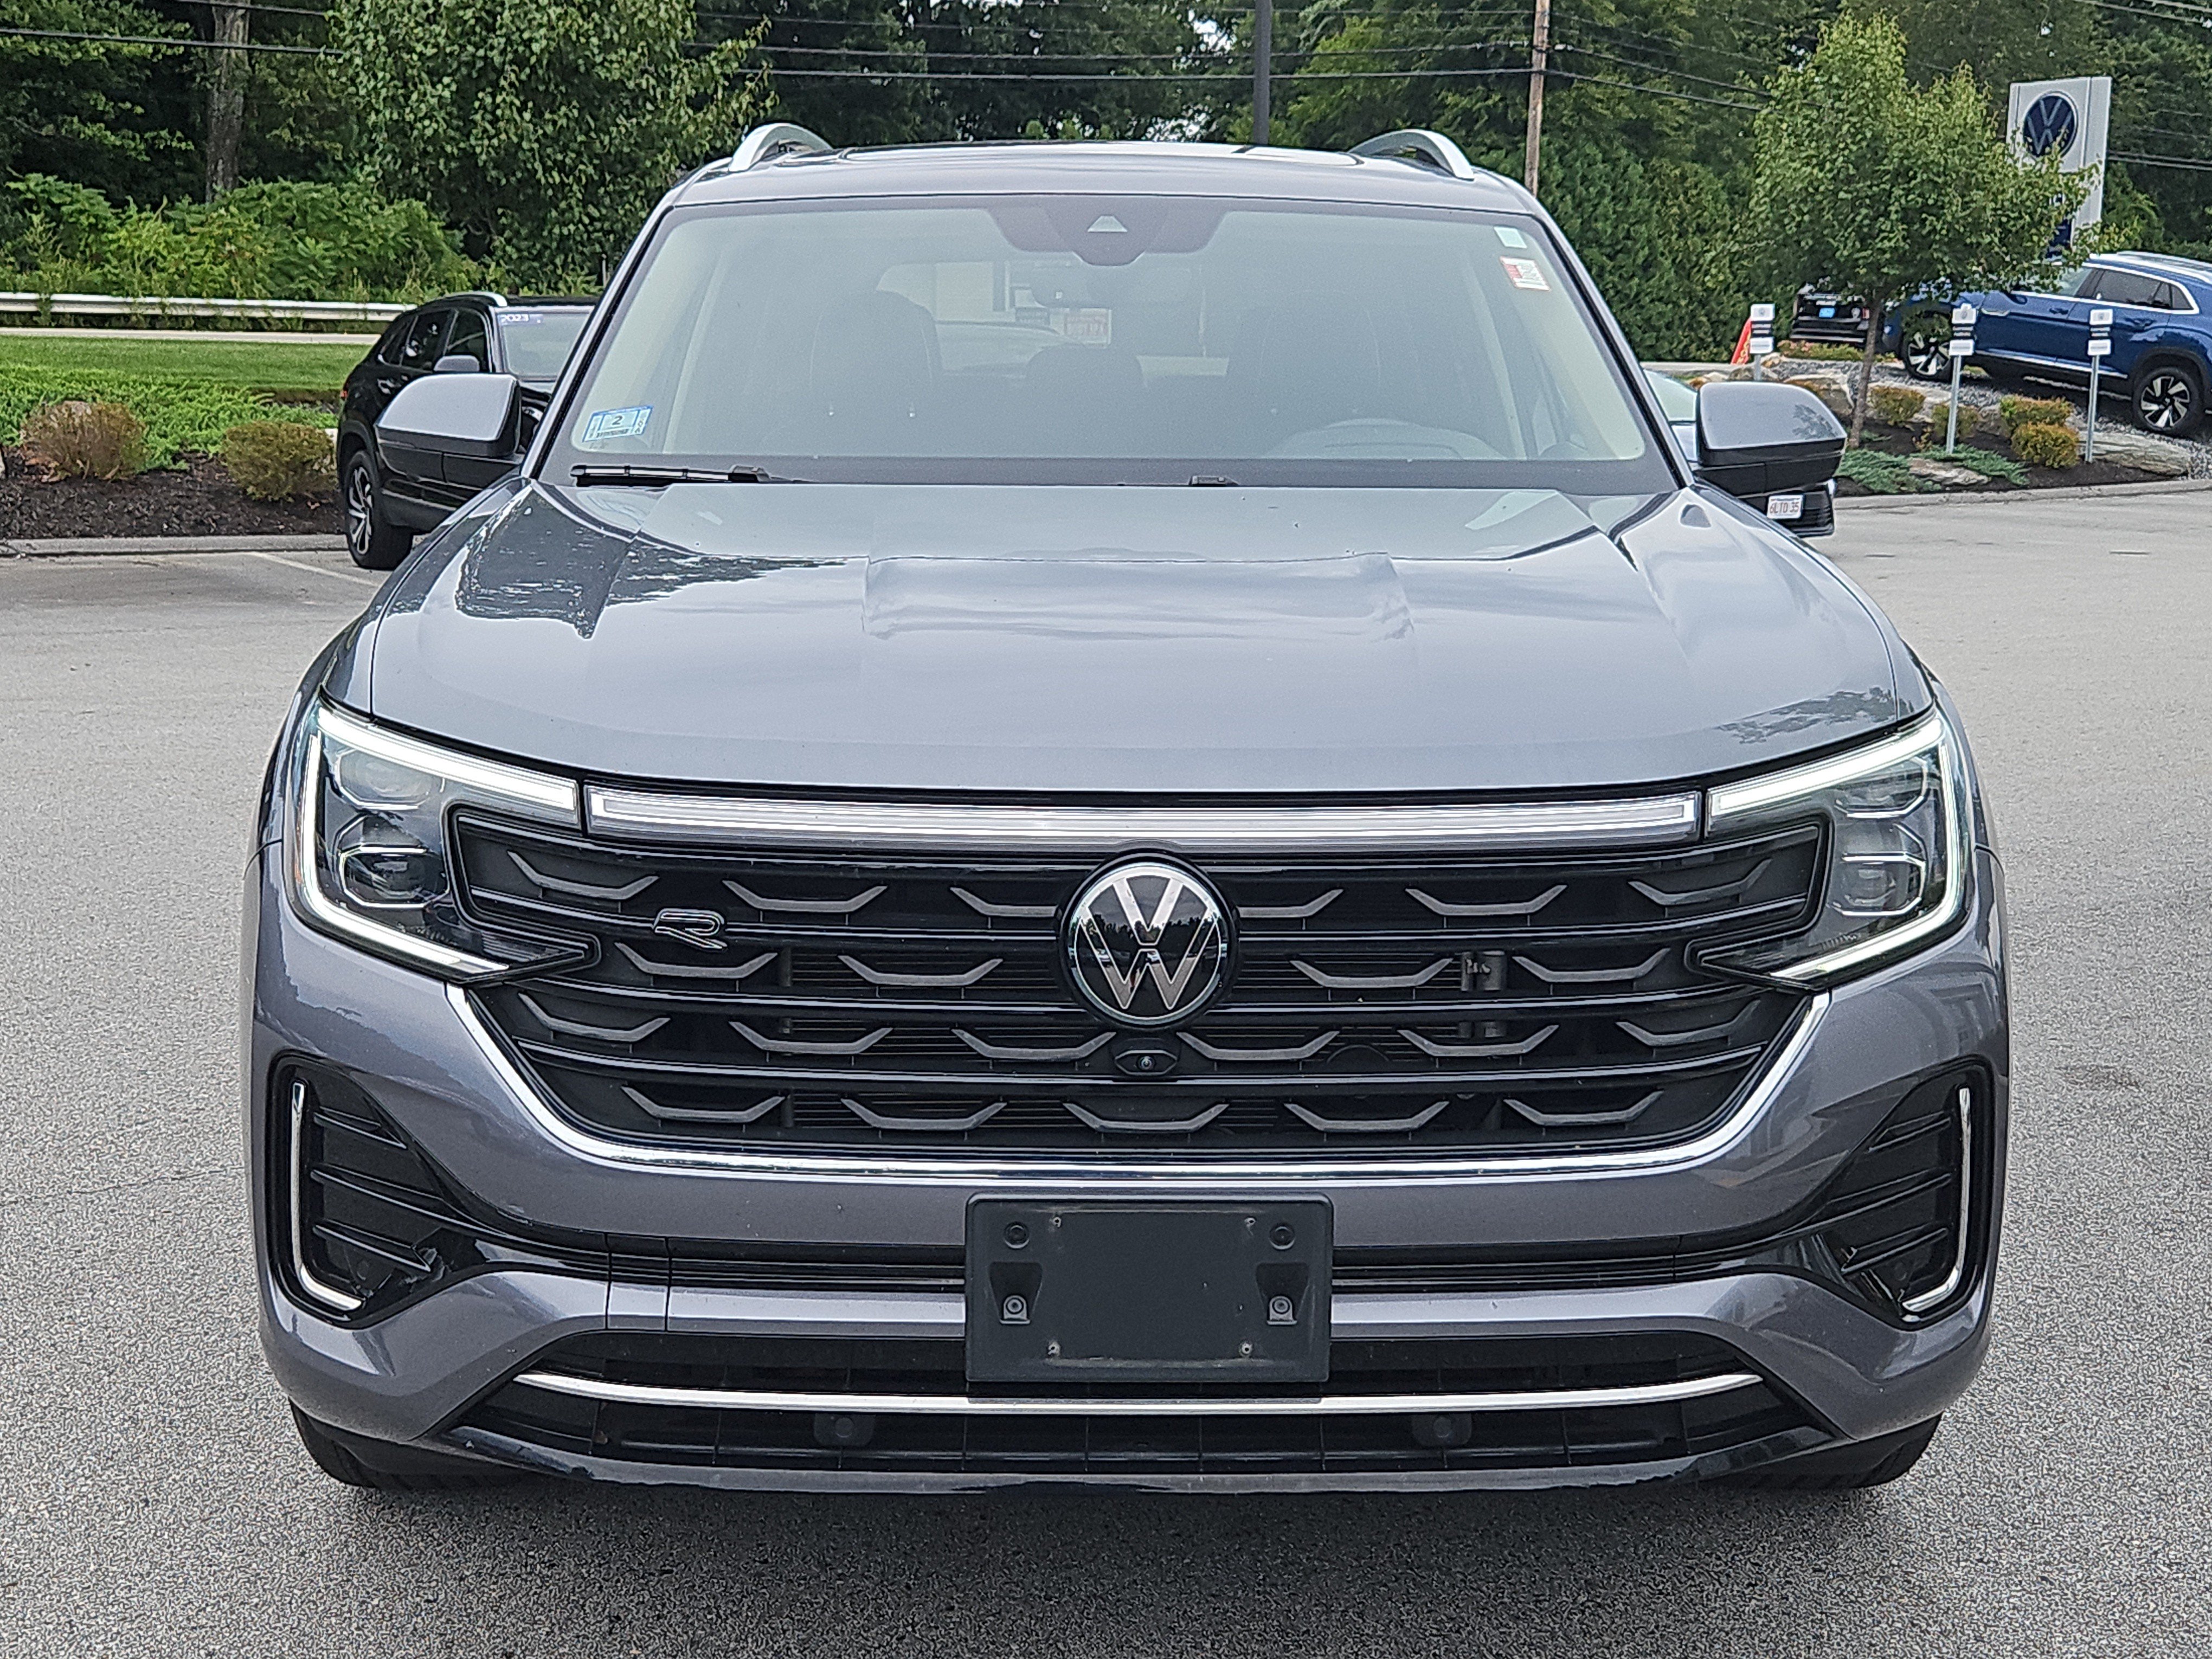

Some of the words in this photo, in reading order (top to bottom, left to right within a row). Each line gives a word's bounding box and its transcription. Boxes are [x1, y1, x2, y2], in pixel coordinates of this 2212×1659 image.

[2027, 98, 2073, 156] VW
[612, 415, 623, 426] 2
[1789, 501, 1800, 513] 35
[653, 908, 729, 952] R
[1076, 876, 1219, 1011] VW
